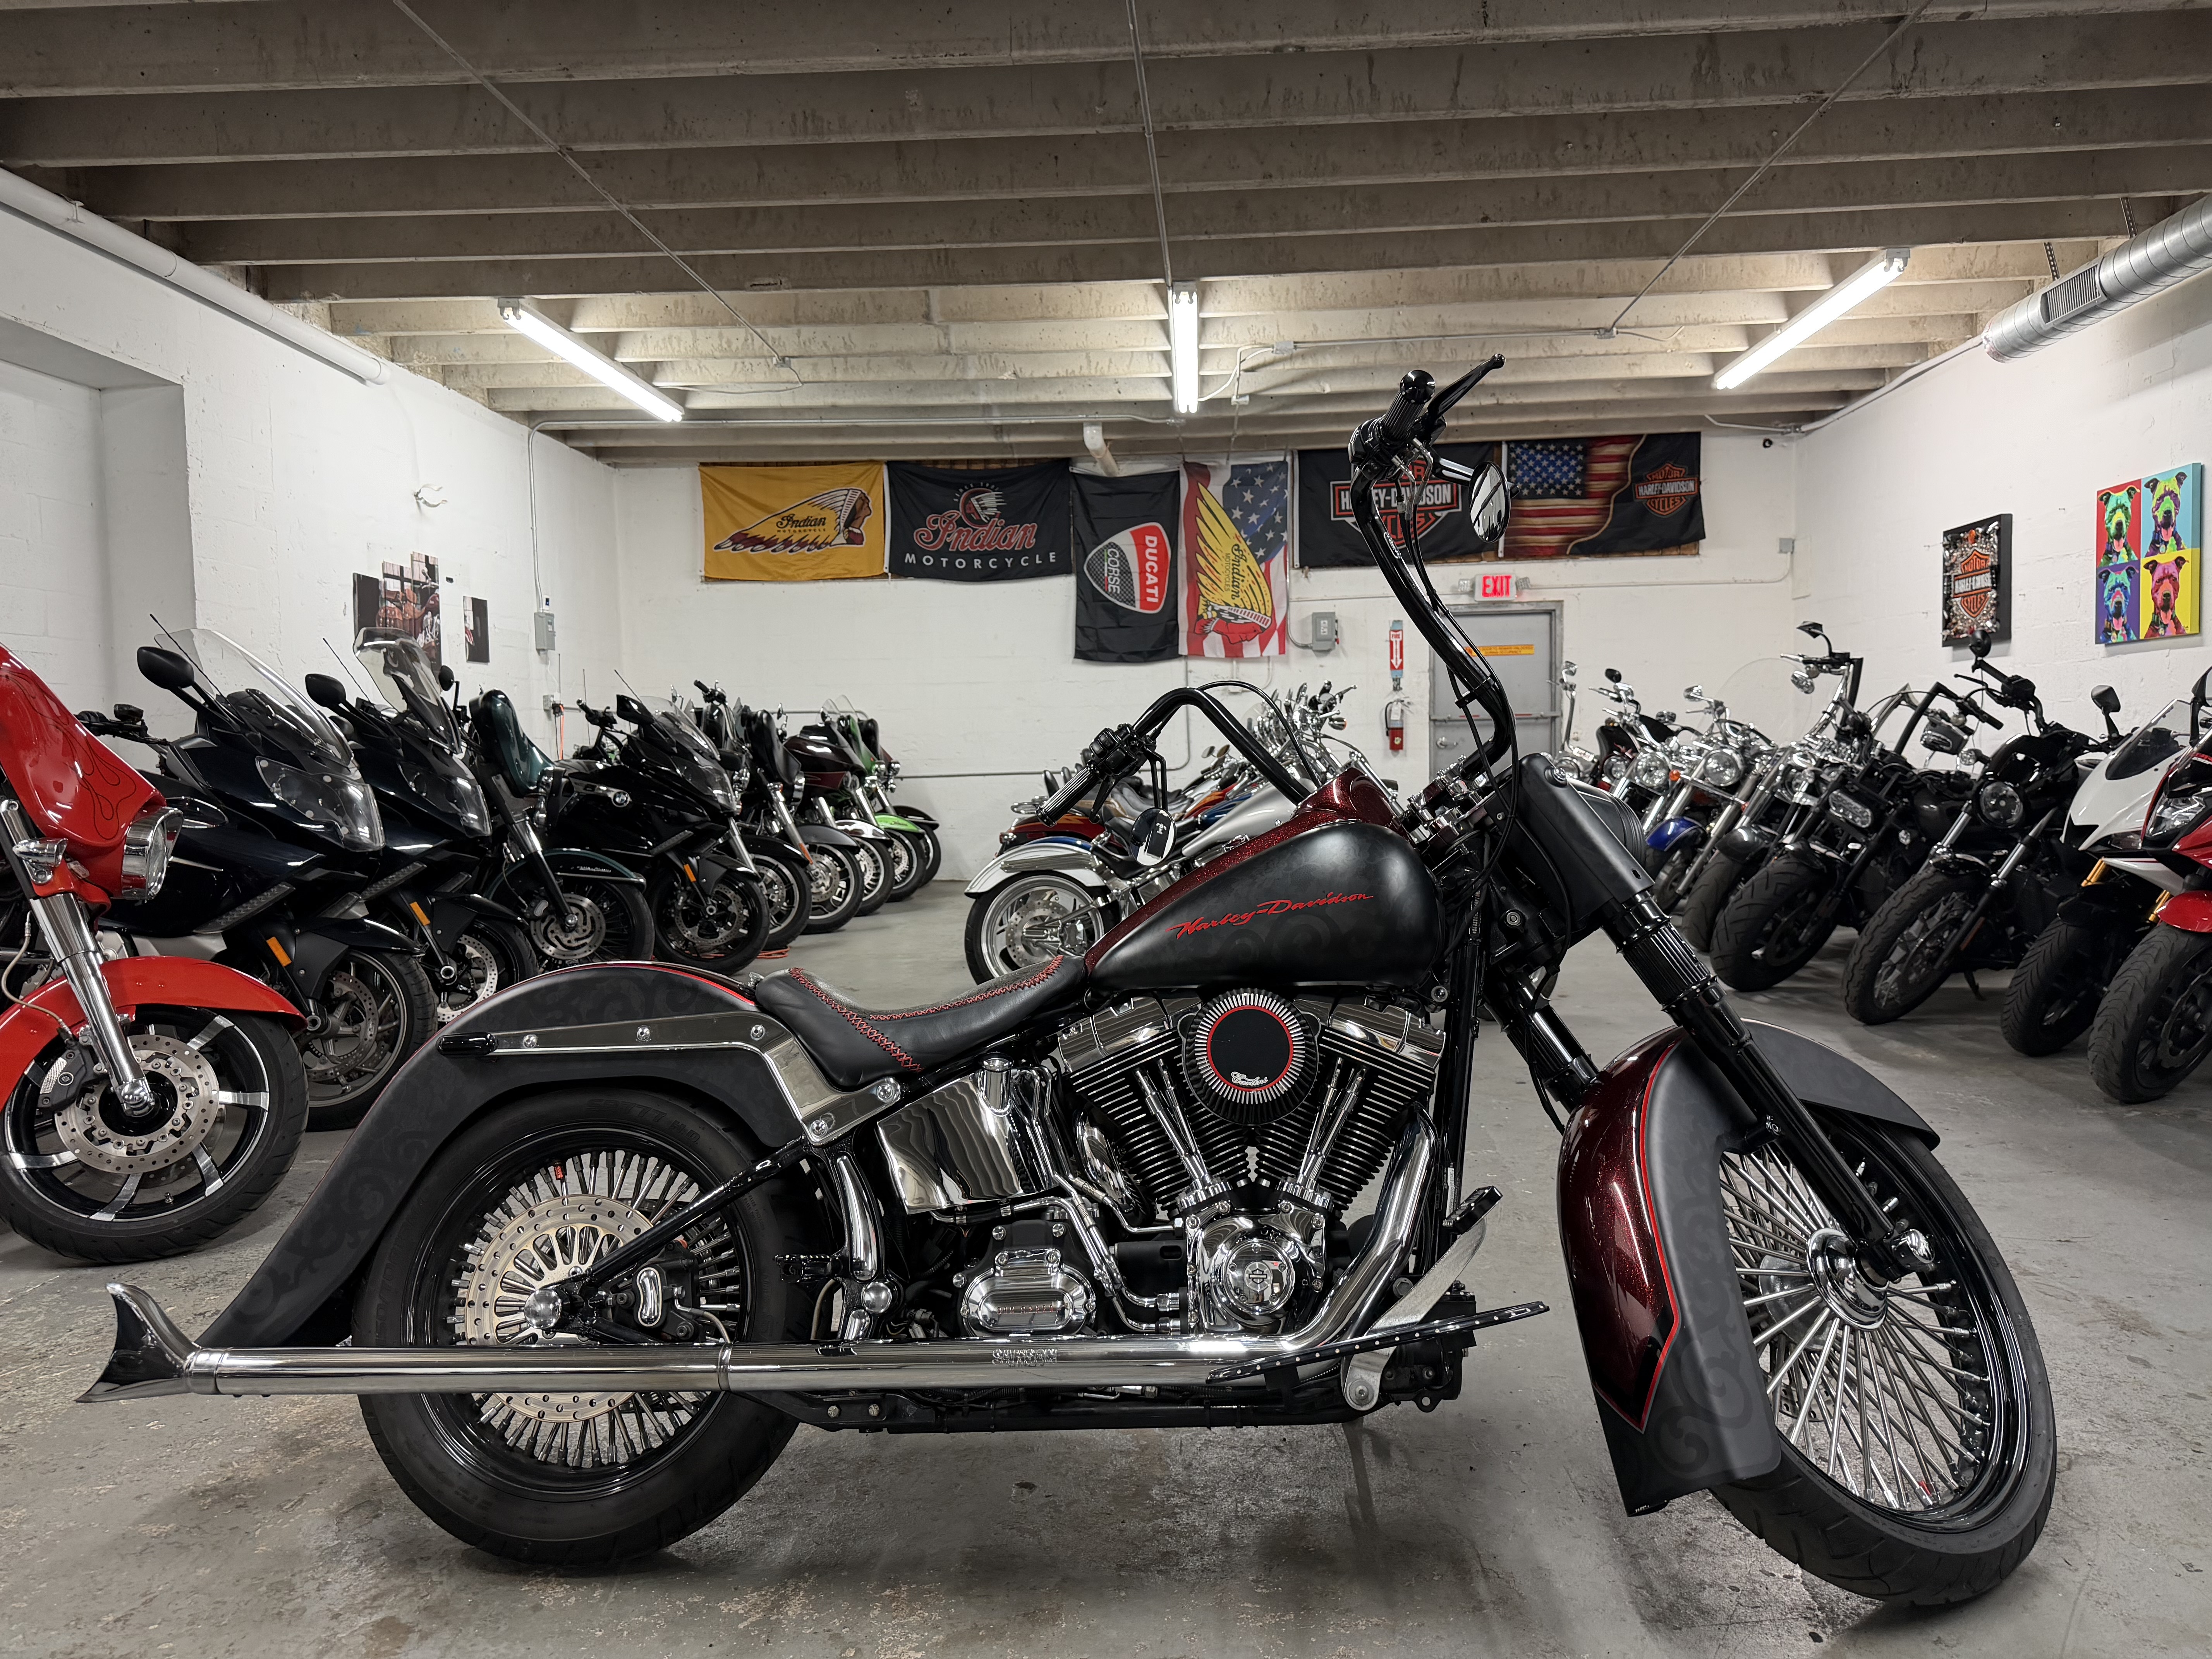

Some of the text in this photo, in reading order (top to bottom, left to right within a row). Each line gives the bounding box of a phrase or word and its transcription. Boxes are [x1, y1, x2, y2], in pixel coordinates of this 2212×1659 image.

[776, 514, 826, 529] Indian
[1650, 496, 1681, 512] CYCLES
[914, 510, 1037, 551] Indian
[905, 552, 1056, 568] MOTORCYCLE
[1108, 548, 1121, 594] CORSE
[1145, 535, 1159, 603] DUCATI
[1231, 544, 1247, 600] Indian
[1482, 575, 1512, 598] EXIT
[1165, 892, 1374, 939] Harley-Davidson
